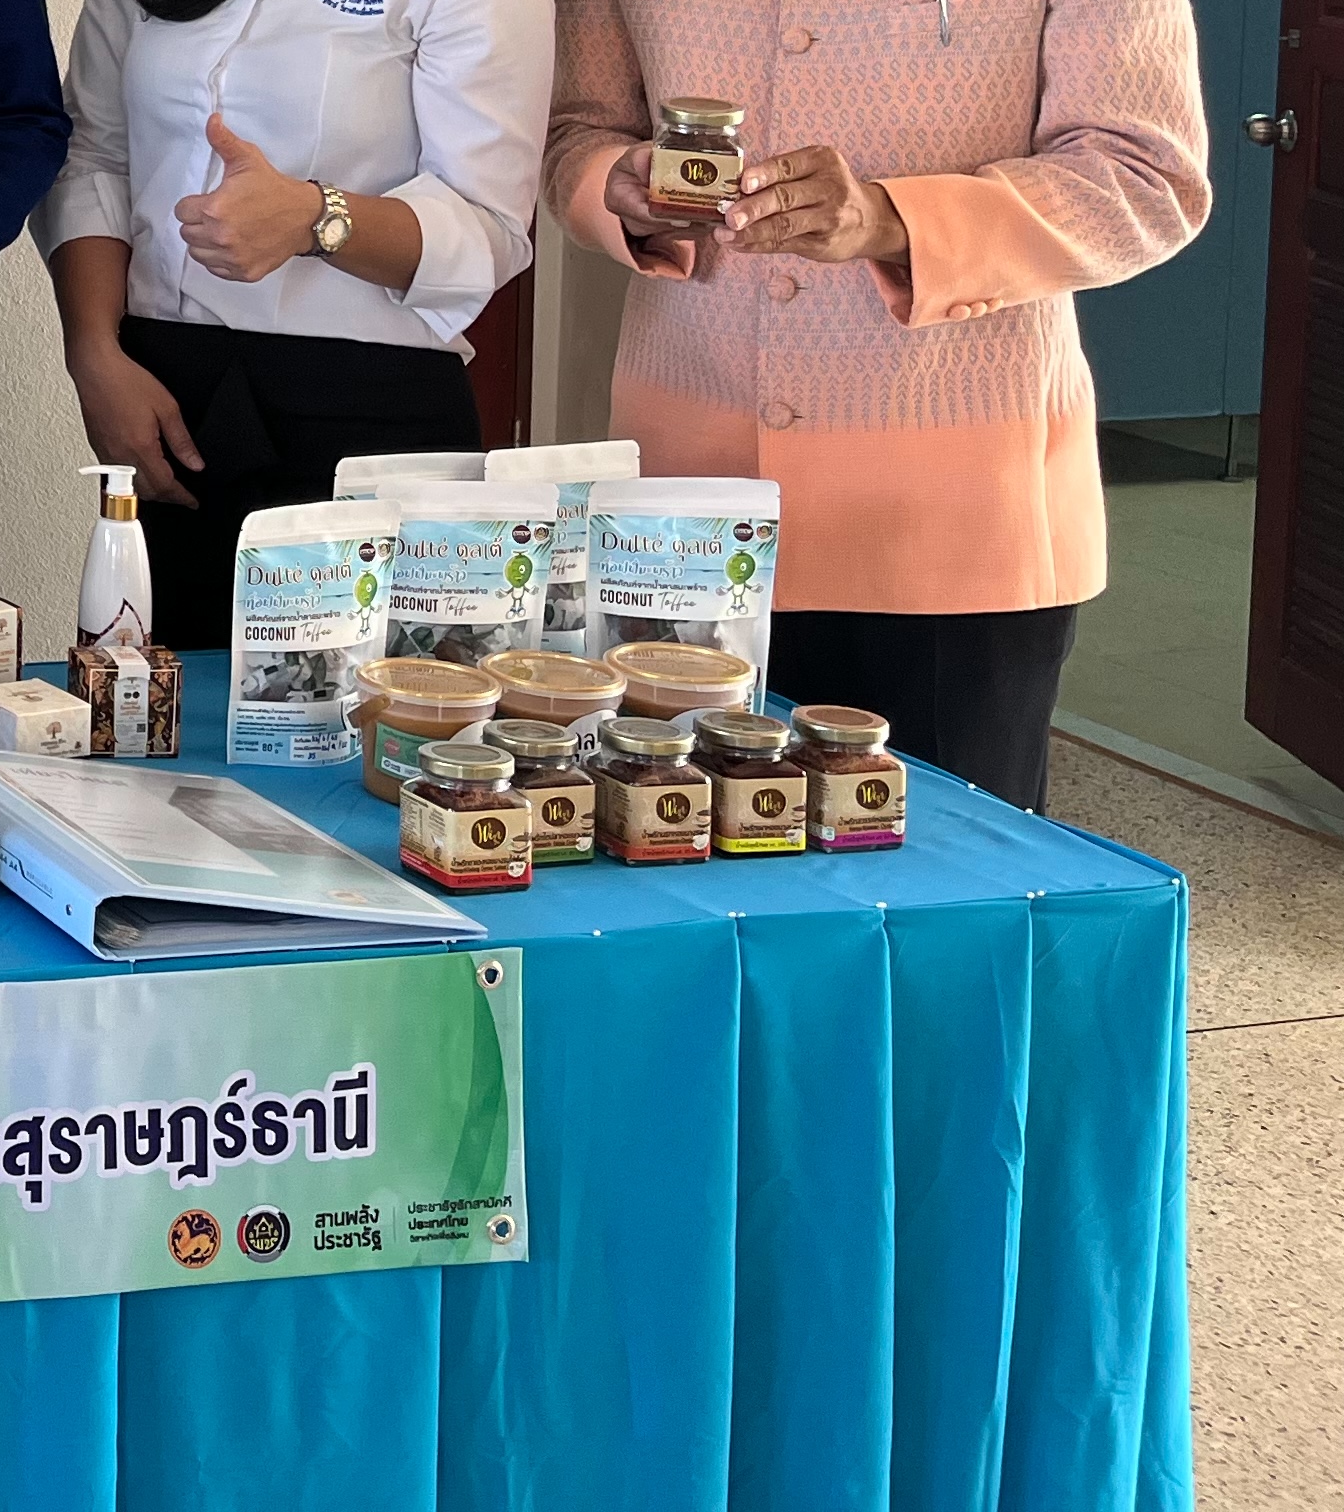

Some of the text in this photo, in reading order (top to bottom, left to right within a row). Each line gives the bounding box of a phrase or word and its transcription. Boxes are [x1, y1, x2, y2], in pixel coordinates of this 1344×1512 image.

[442, 595, 479, 617] Toffee
[599, 589, 697, 612] COCONUT Toffee
[245, 621, 333, 643] COCONUT Toffee
[314, 1204, 380, 1229] สานพลัง
[313, 1226, 383, 1252] ประชารัฐ
